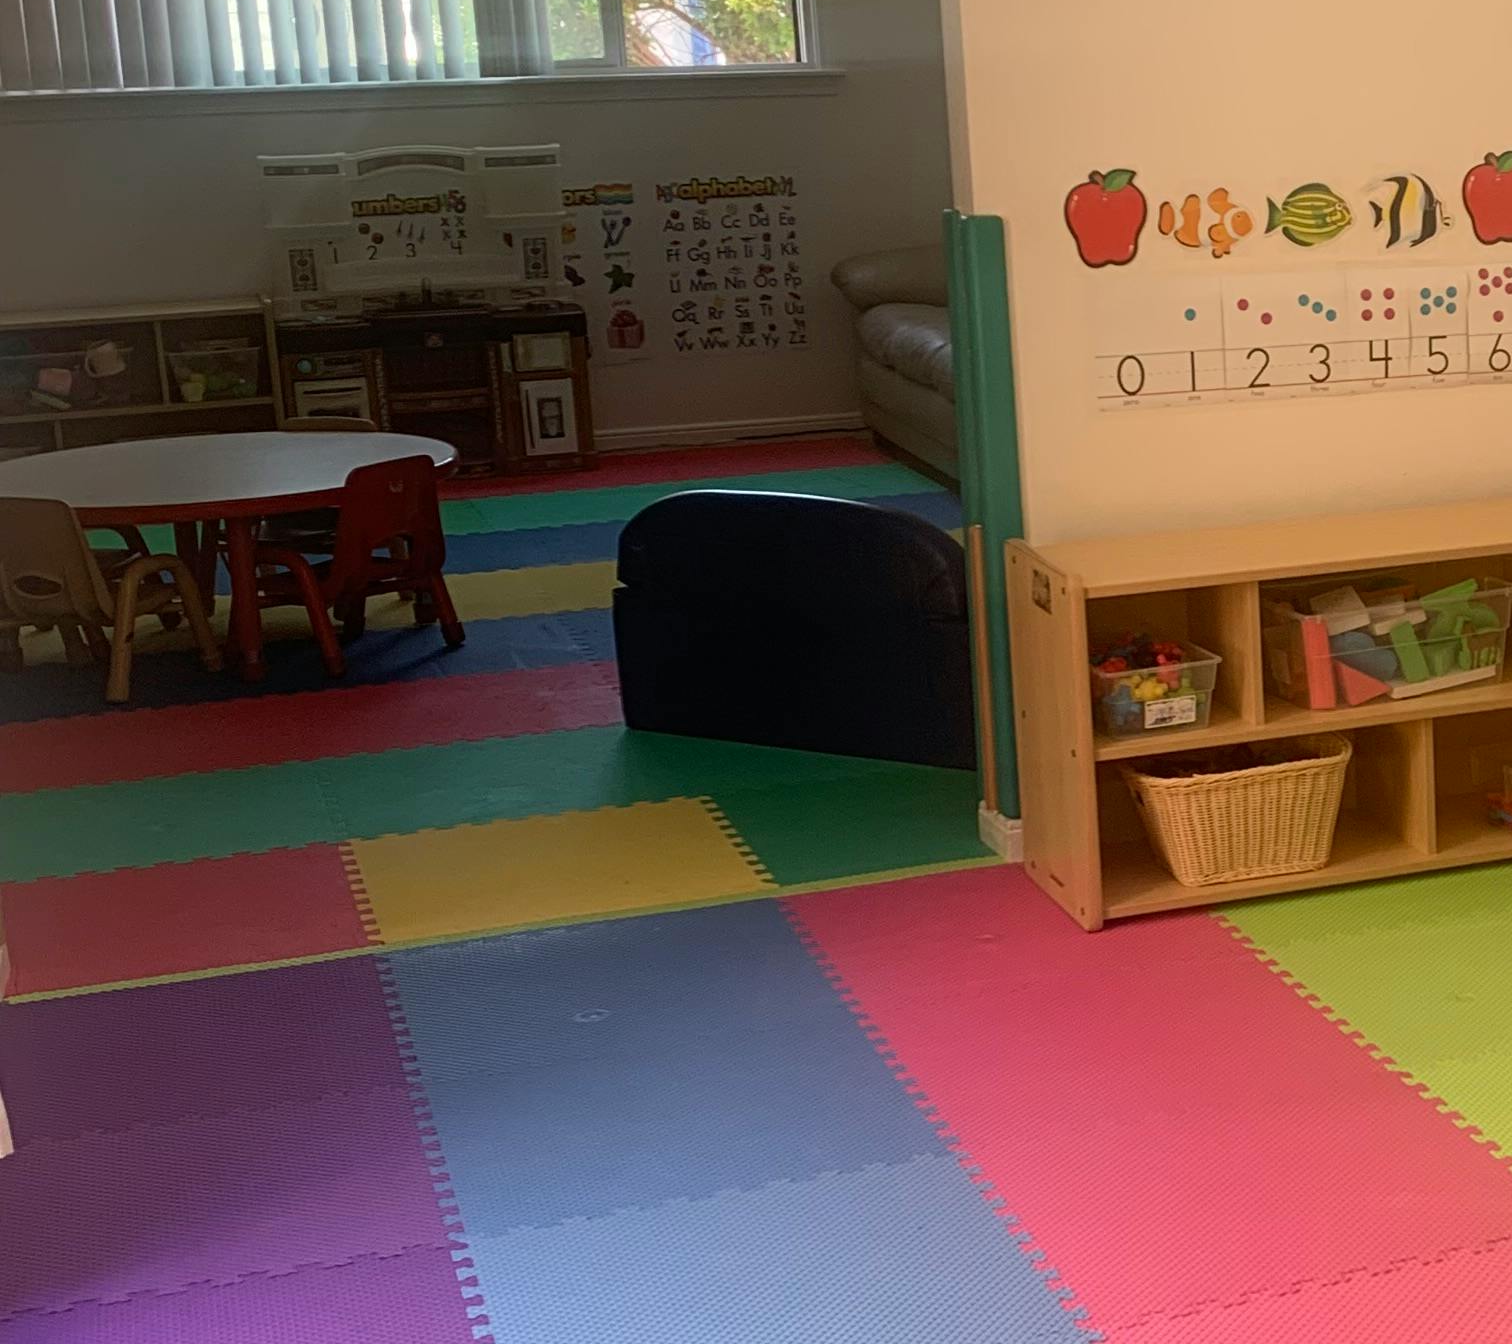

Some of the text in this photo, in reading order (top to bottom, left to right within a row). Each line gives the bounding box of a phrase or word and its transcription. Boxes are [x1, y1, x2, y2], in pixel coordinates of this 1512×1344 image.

[677, 176, 776, 204] alphabet
[350, 194, 441, 217] umbers
[663, 212, 796, 232] Aa Bb Cc Dd Ee
[367, 245, 379, 260] 2
[406, 243, 419, 258] 3
[451, 241, 464, 255] 4
[666, 248, 680, 262] Ff
[687, 247, 711, 265] Gg
[716, 246, 738, 259] Hh
[761, 244, 772, 260] Jj
[780, 242, 800, 256] Kk
[689, 279, 717, 292] Mm
[724, 277, 746, 290] Nn
[753, 274, 778, 288] Oo
[784, 273, 802, 288] Pp
[672, 308, 700, 325] Qq
[708, 307, 724, 320] Rr
[735, 305, 750, 318] Ss
[784, 301, 805, 315] Uu
[674, 331, 808, 352] Vv Ww Xx Yy Zz
[1117, 355, 1145, 396] 0
[1190, 351, 1196, 392] 1
[1246, 347, 1271, 389] 2
[1308, 344, 1331, 383] 3
[1368, 339, 1393, 379] 4
[1427, 335, 1450, 375] 5
[1489, 333, 1511, 372] 6
